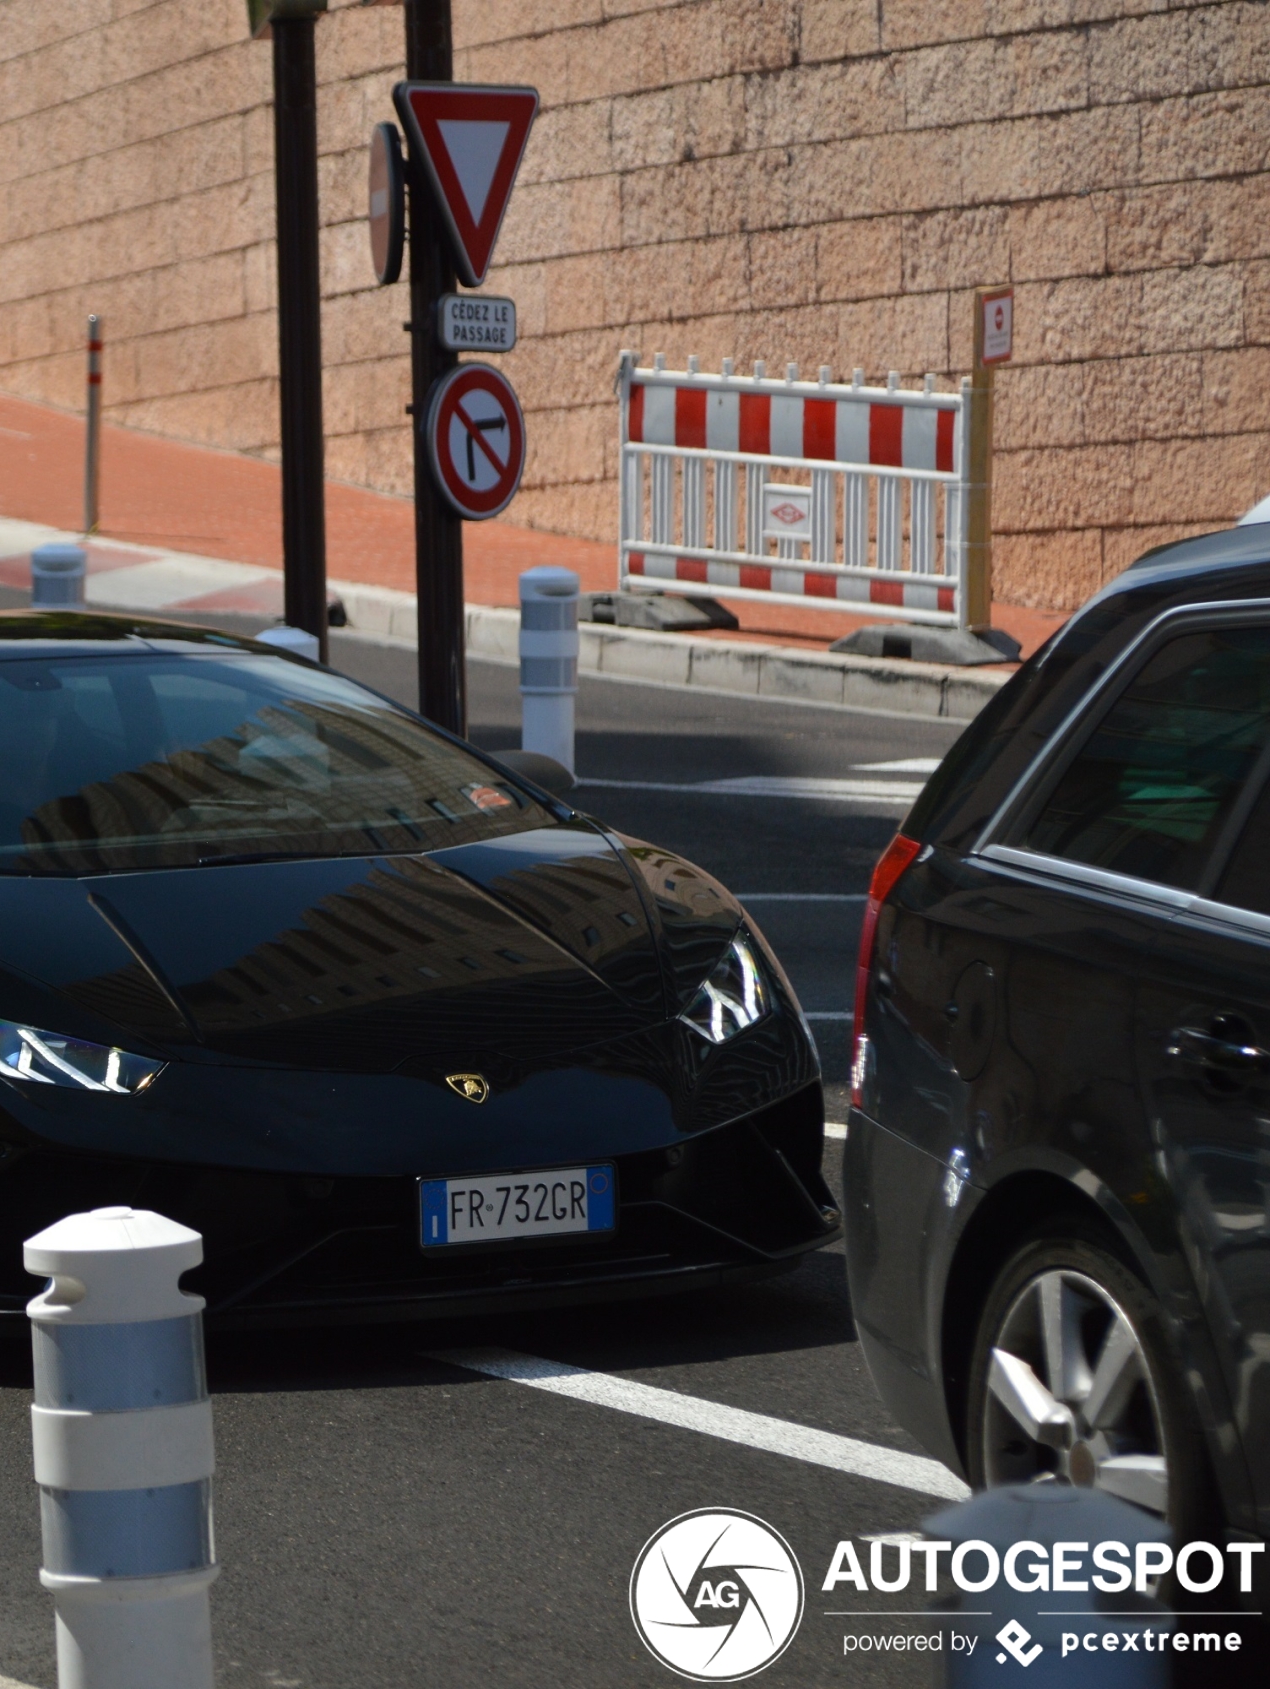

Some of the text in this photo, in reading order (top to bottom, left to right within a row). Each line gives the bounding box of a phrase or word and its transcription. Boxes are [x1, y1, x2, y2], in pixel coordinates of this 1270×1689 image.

[451, 299, 508, 322] CÉDEZ LE
[453, 324, 507, 344] PASSAGE
